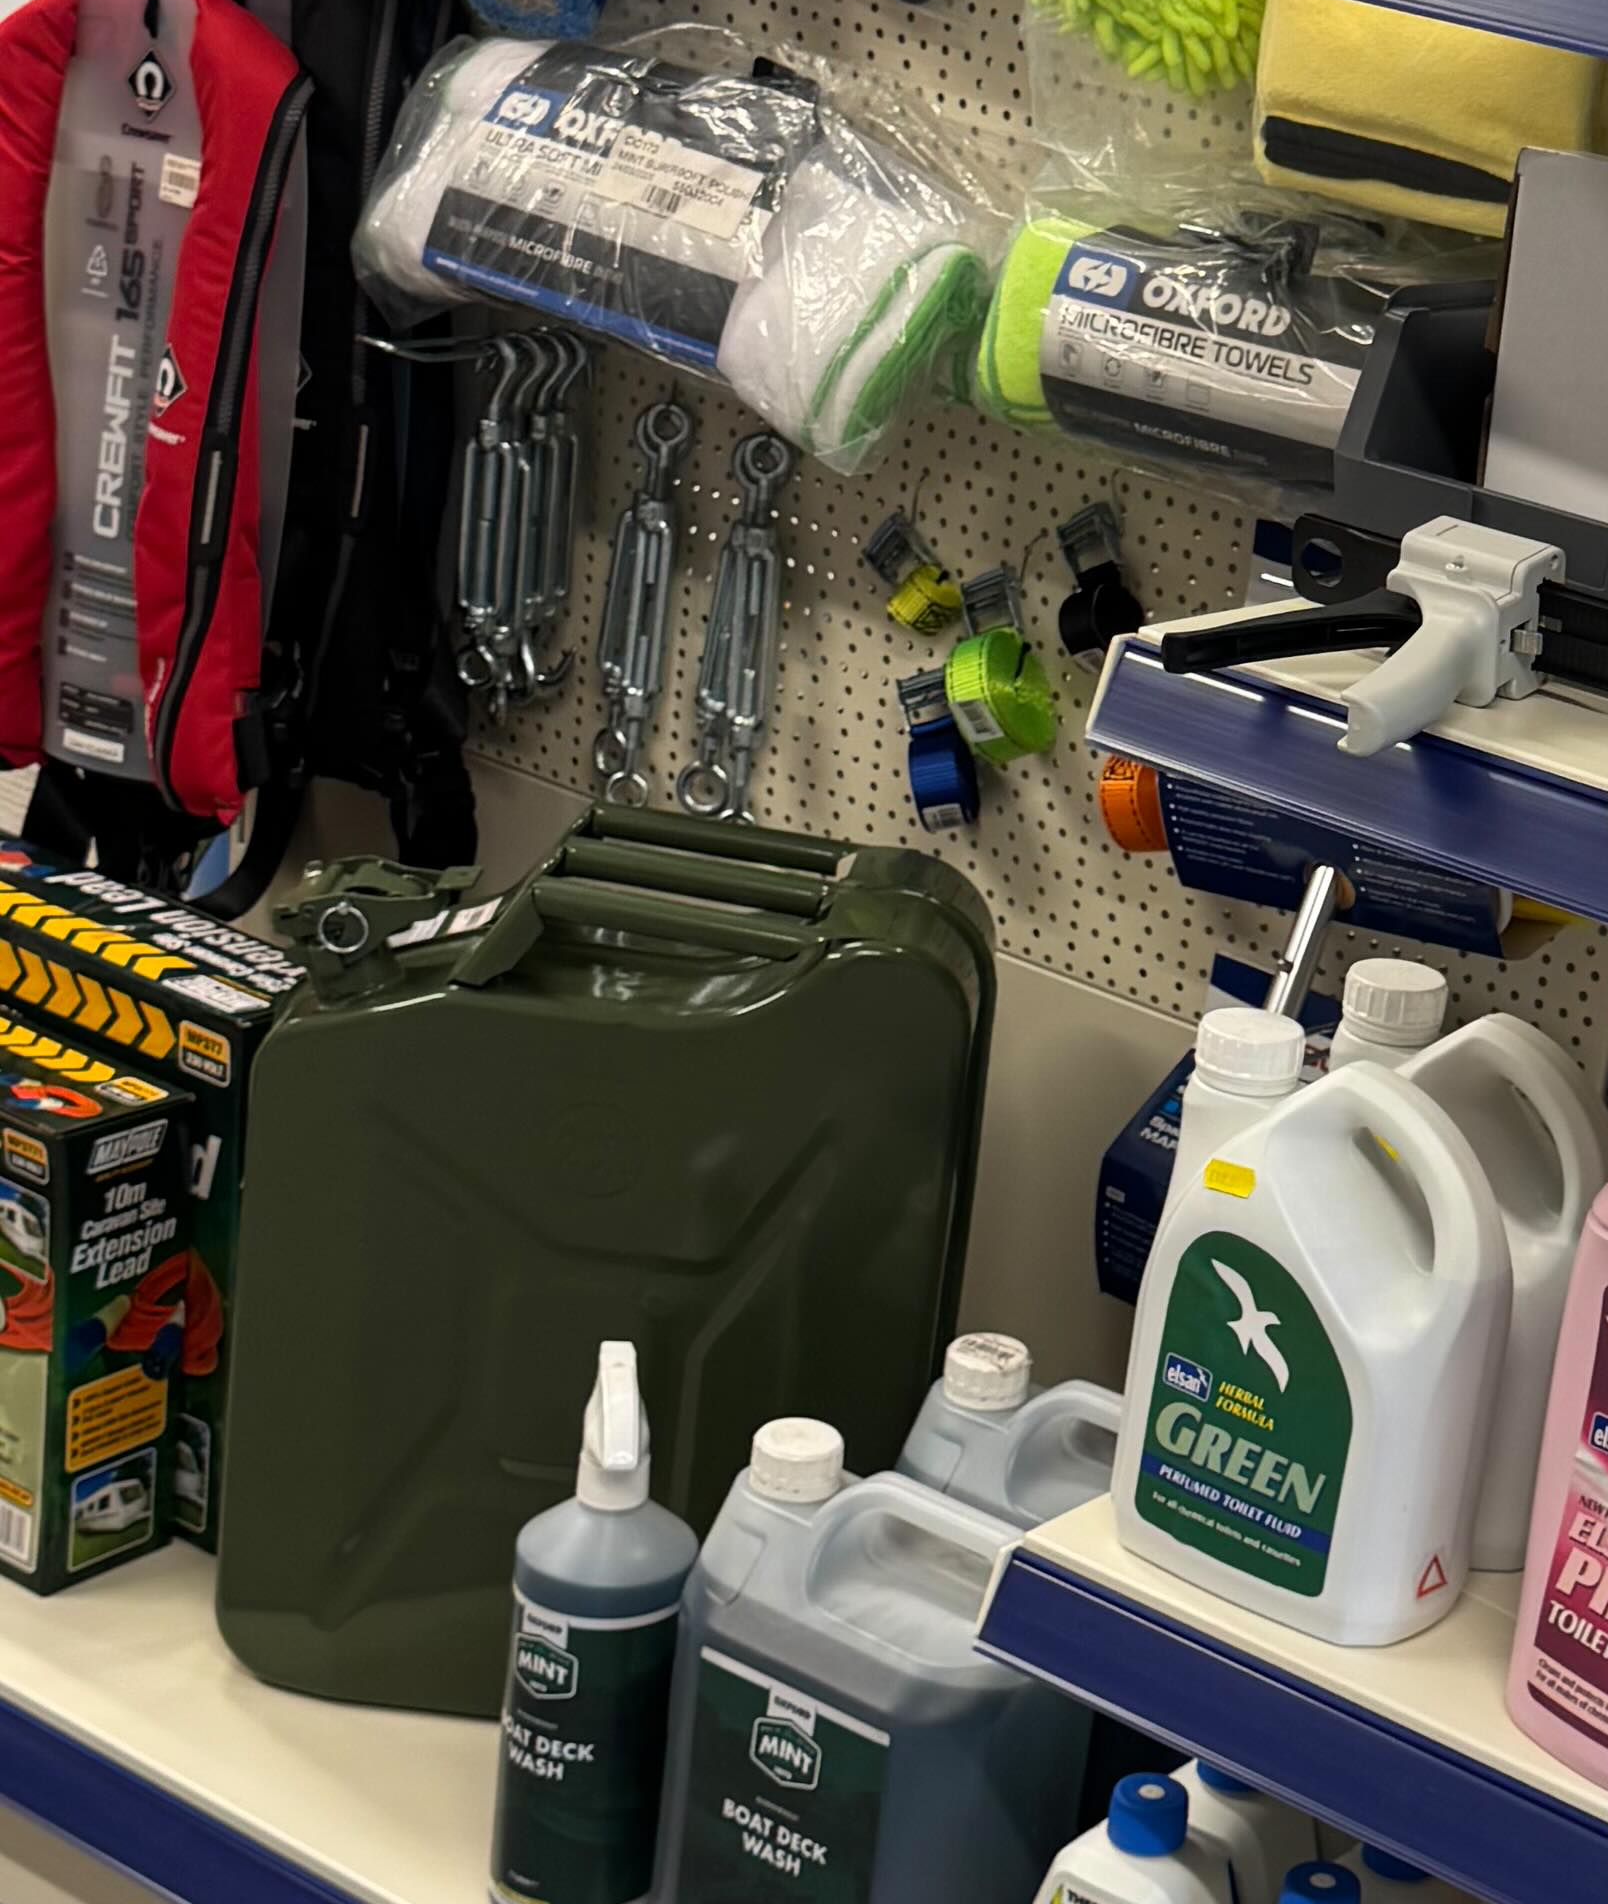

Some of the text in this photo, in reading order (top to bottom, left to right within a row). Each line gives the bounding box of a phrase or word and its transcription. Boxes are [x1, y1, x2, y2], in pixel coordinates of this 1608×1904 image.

[124, 161, 146, 244] SPORT
[509, 236, 593, 274] MICROFIBRE
[115, 248, 146, 322] 165
[1142, 274, 1292, 338] OXFORD
[1058, 302, 1315, 386] MICROFIBRE TOWELS
[93, 334, 136, 540] CREWFIT
[1133, 421, 1233, 458] MICROFIBRE
[94, 1122, 165, 1170] MAYPOLE
[104, 1181, 147, 1214] 10m
[81, 1199, 168, 1241] Caravan Site
[70, 1217, 178, 1275] Extension
[94, 1247, 152, 1290] Lead
[1167, 1363, 1201, 1394] elsan
[1218, 1381, 1265, 1411] HERBAL
[1215, 1396, 1275, 1432] FORMULA
[1155, 1401, 1327, 1514] GREEN
[1159, 1463, 1302, 1539] PERFUMED TOILET FLUID
[1579, 1495, 1605, 1520] NEW
[518, 1650, 569, 1685] MINT
[508, 1741, 565, 1781] WASH
[758, 1733, 814, 1776] MINT
[722, 1797, 828, 1865] BOAT DECK
[742, 1831, 801, 1877] WASH
